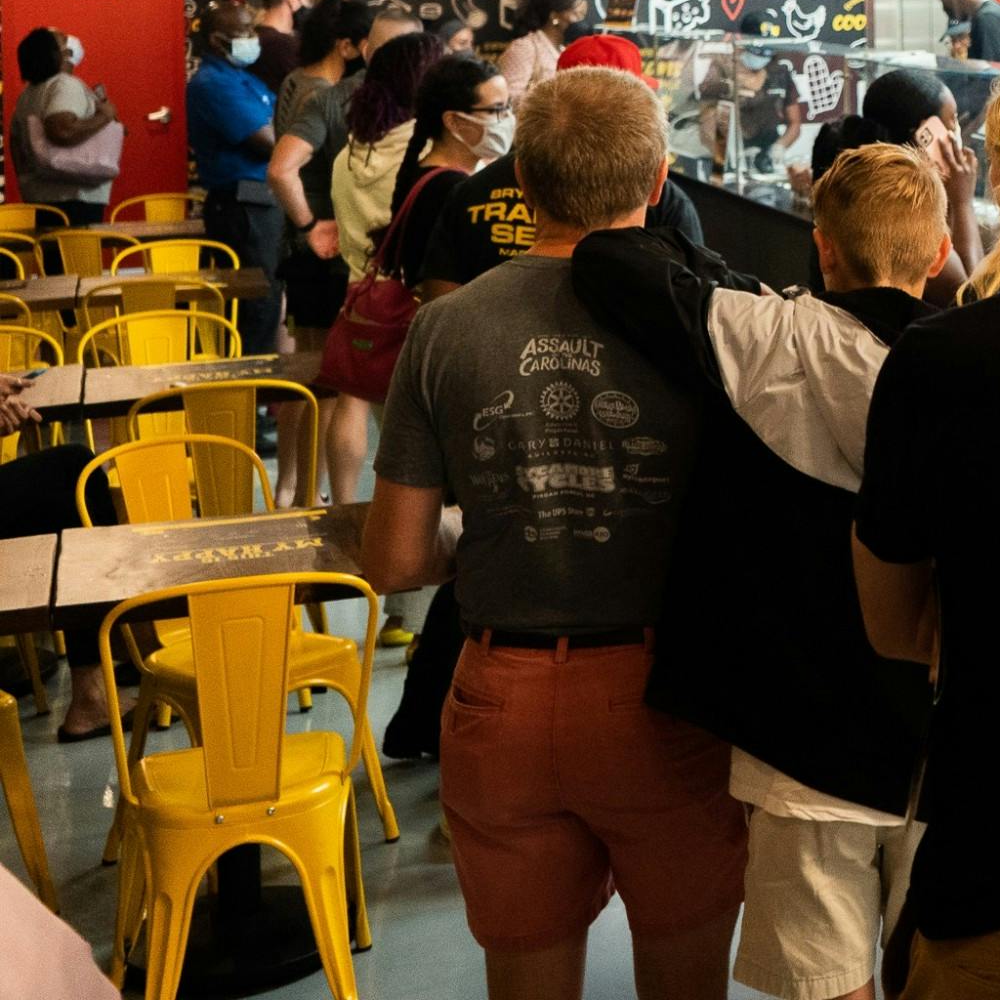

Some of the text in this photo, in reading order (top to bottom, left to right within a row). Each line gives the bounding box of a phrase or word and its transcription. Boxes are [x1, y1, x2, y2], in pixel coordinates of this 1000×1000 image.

[520, 338, 604, 359] ASSAULT
[482, 406, 504, 417] ESG
[538, 507, 551, 518] The
[272, 536, 324, 553] MY
